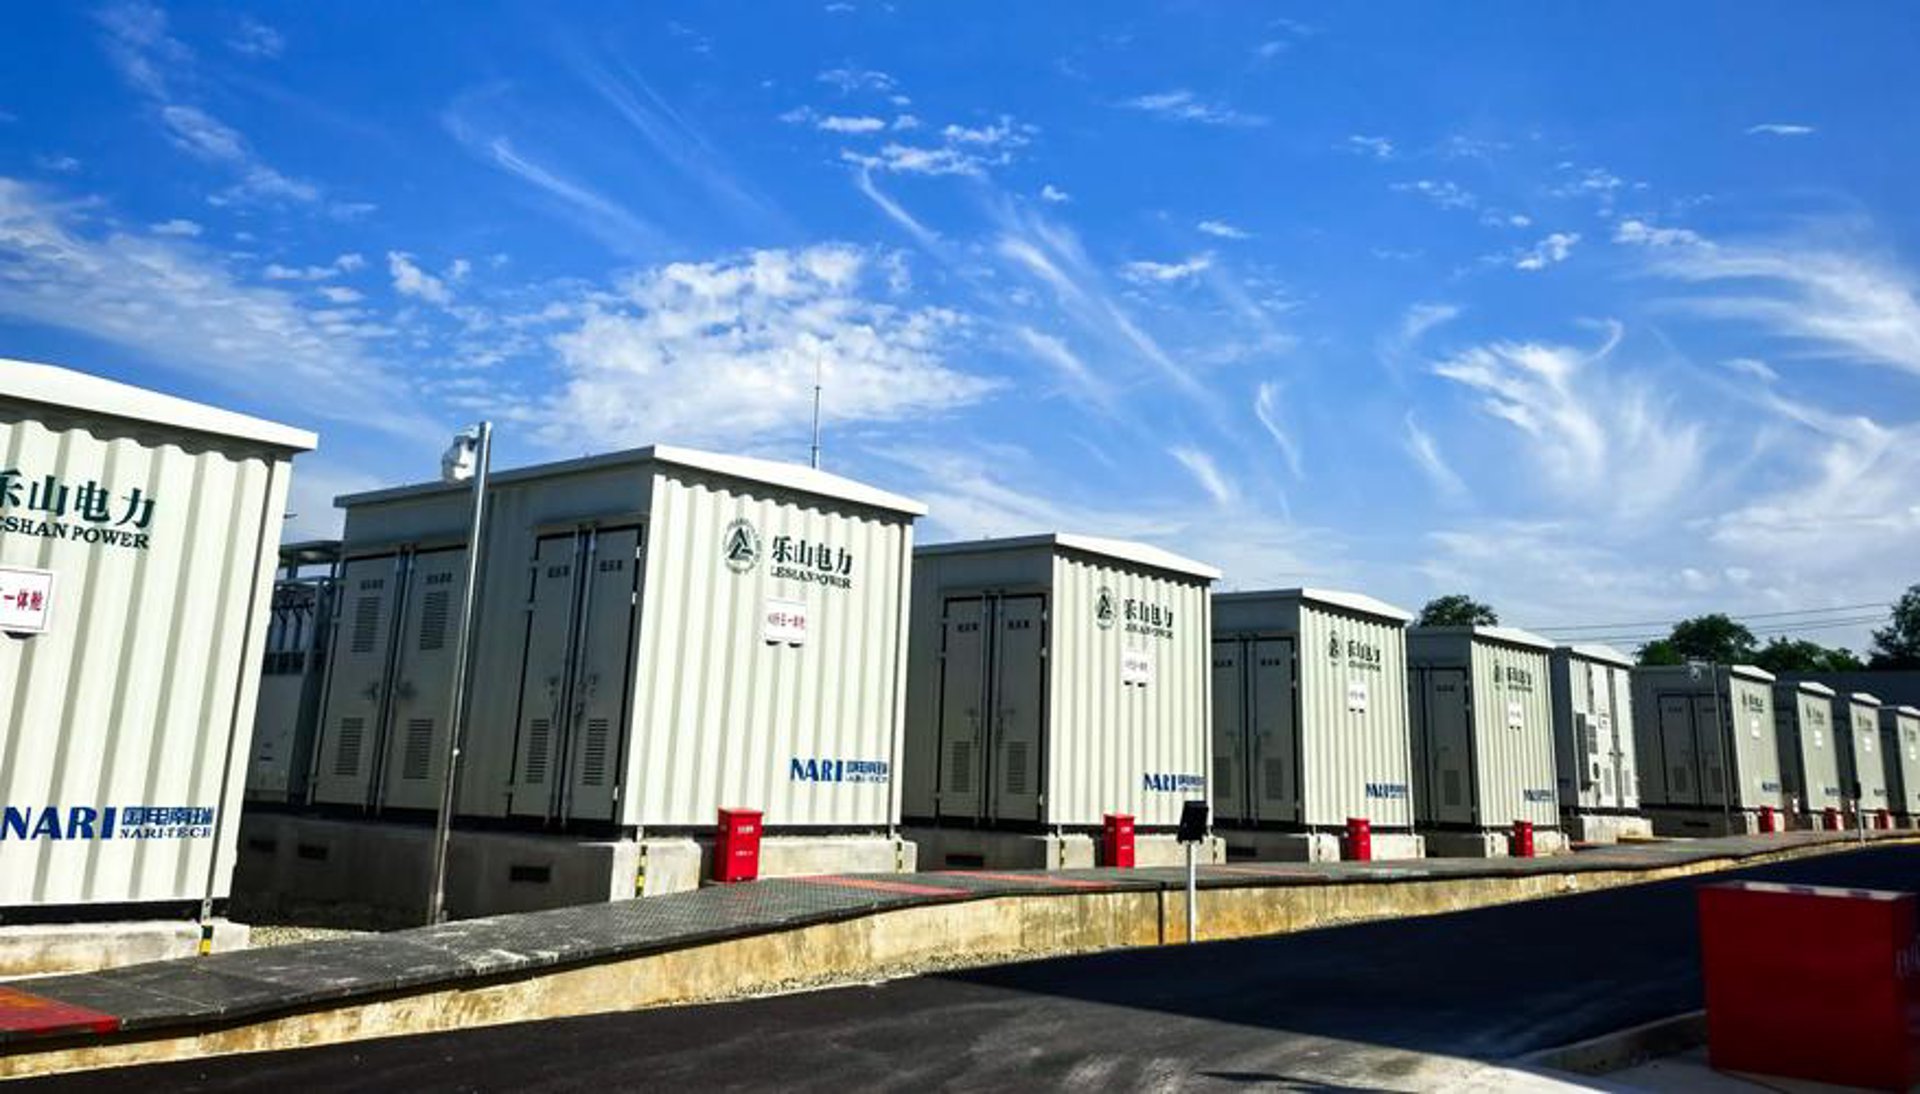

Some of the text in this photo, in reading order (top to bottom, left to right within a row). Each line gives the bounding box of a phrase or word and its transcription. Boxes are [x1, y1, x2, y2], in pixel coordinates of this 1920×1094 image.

[71, 524, 150, 549] POWER
[771, 535, 853, 576] 乐山电力
[0, 587, 42, 611] 一体舱
[790, 758, 843, 782] NARI
[0, 806, 117, 840] NARI
